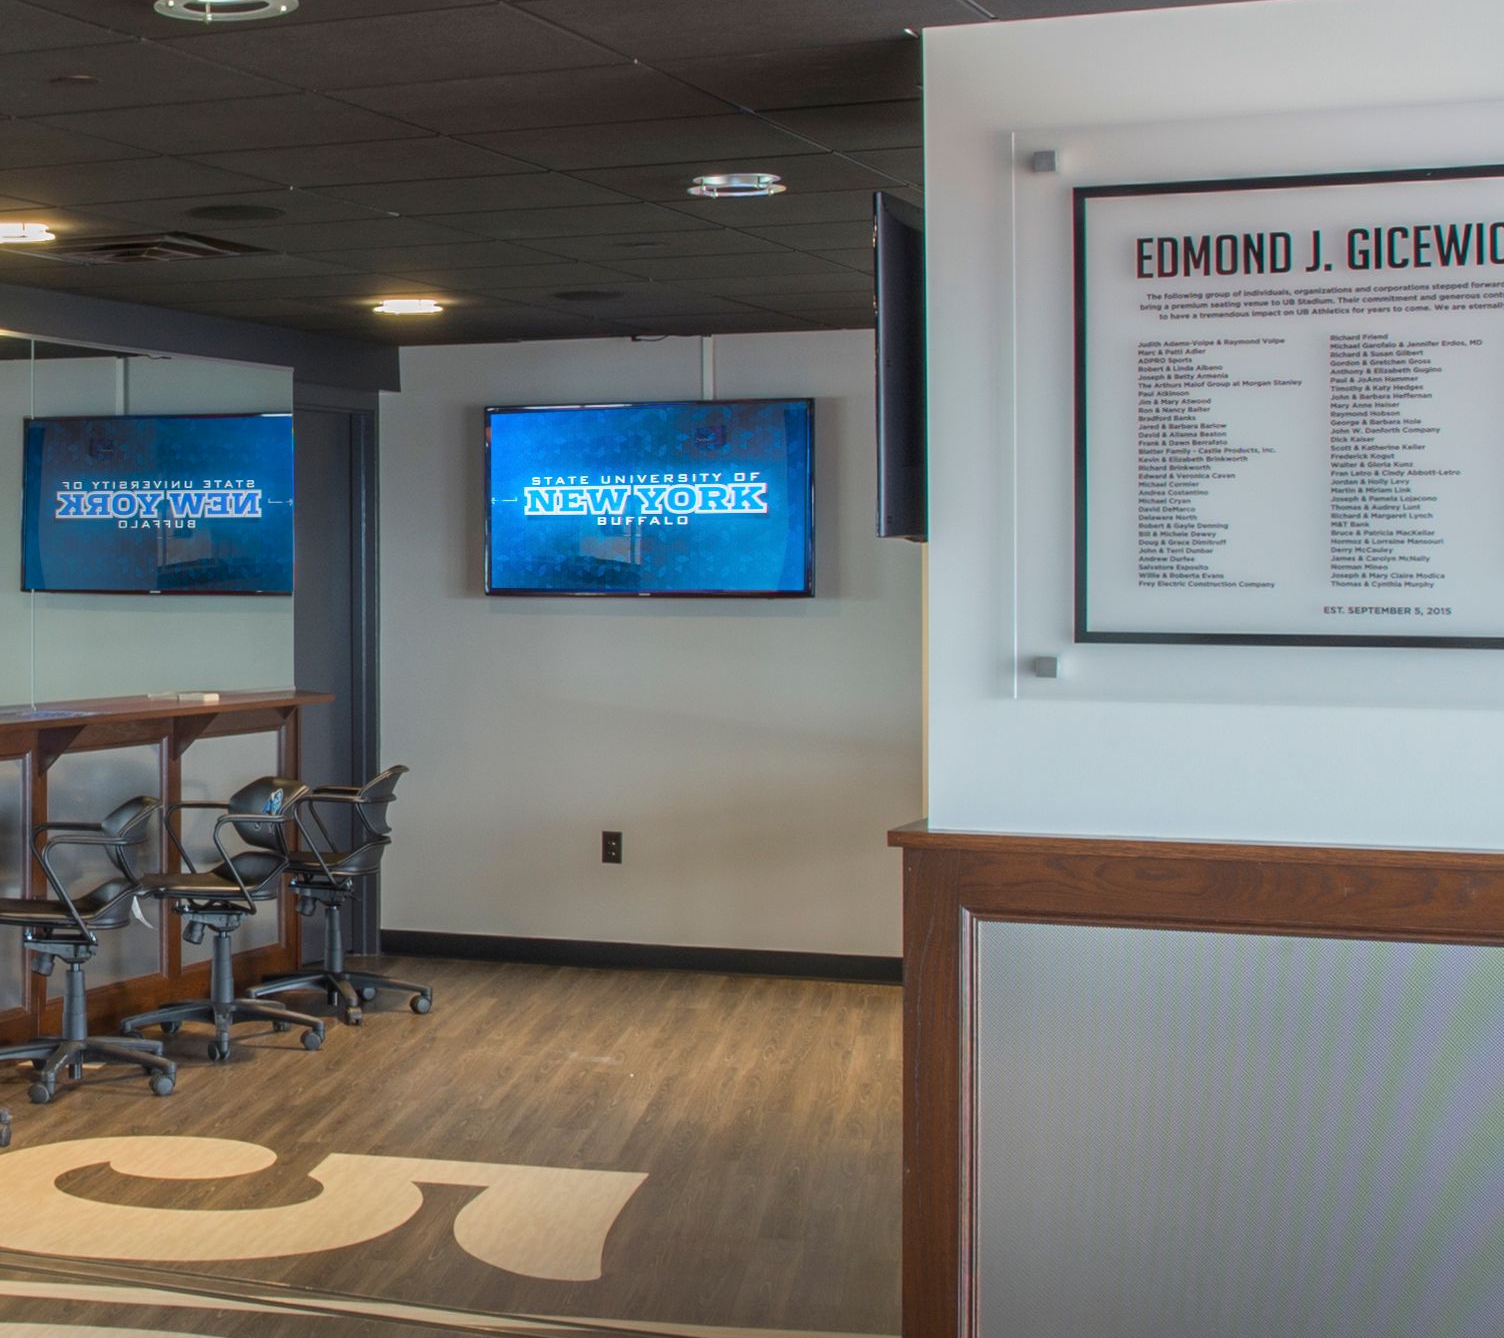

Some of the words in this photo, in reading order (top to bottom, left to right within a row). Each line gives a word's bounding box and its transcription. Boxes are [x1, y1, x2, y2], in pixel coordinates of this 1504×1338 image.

[1137, 231, 1292, 279] EDMOND
[1305, 230, 1333, 273] J.
[1147, 293, 1162, 301] The
[1163, 291, 1203, 302] following
[1204, 292, 1230, 301] group
[1242, 288, 1291, 299] individuals,
[1293, 286, 1352, 297] organizations
[1372, 283, 1429, 295] corporations
[1431, 282, 1469, 293] stepped
[1139, 302, 1162, 312] bring
[1170, 301, 1208, 311] premium
[1210, 300, 1241, 310] seating
[1296, 297, 1335, 305] Stadium.
[1337, 296, 1360, 304] Their
[1361, 294, 1418, 303] commitment
[1419, 293, 1437, 301] and
[1438, 294, 1481, 302] generous
[1169, 312, 1190, 320] have
[1198, 310, 1250, 319] tremendous
[1250, 309, 1281, 319] impact
[1310, 307, 1350, 315] Athletics
[1351, 306, 1364, 314] for
[1366, 307, 1391, 315] years
[531, 475, 589, 485] STATE
[601, 472, 722, 484] UNIVERSITY
[734, 472, 761, 482] OF
[524, 485, 633, 515] NEW
[634, 482, 768, 514] YORK
[597, 516, 689, 526] BUFFALO
[1323, 605, 1344, 613] EST.
[1347, 606, 1411, 614] SEPTEMBER
[1414, 607, 1423, 616] 5,
[1426, 607, 1451, 615] 2015
